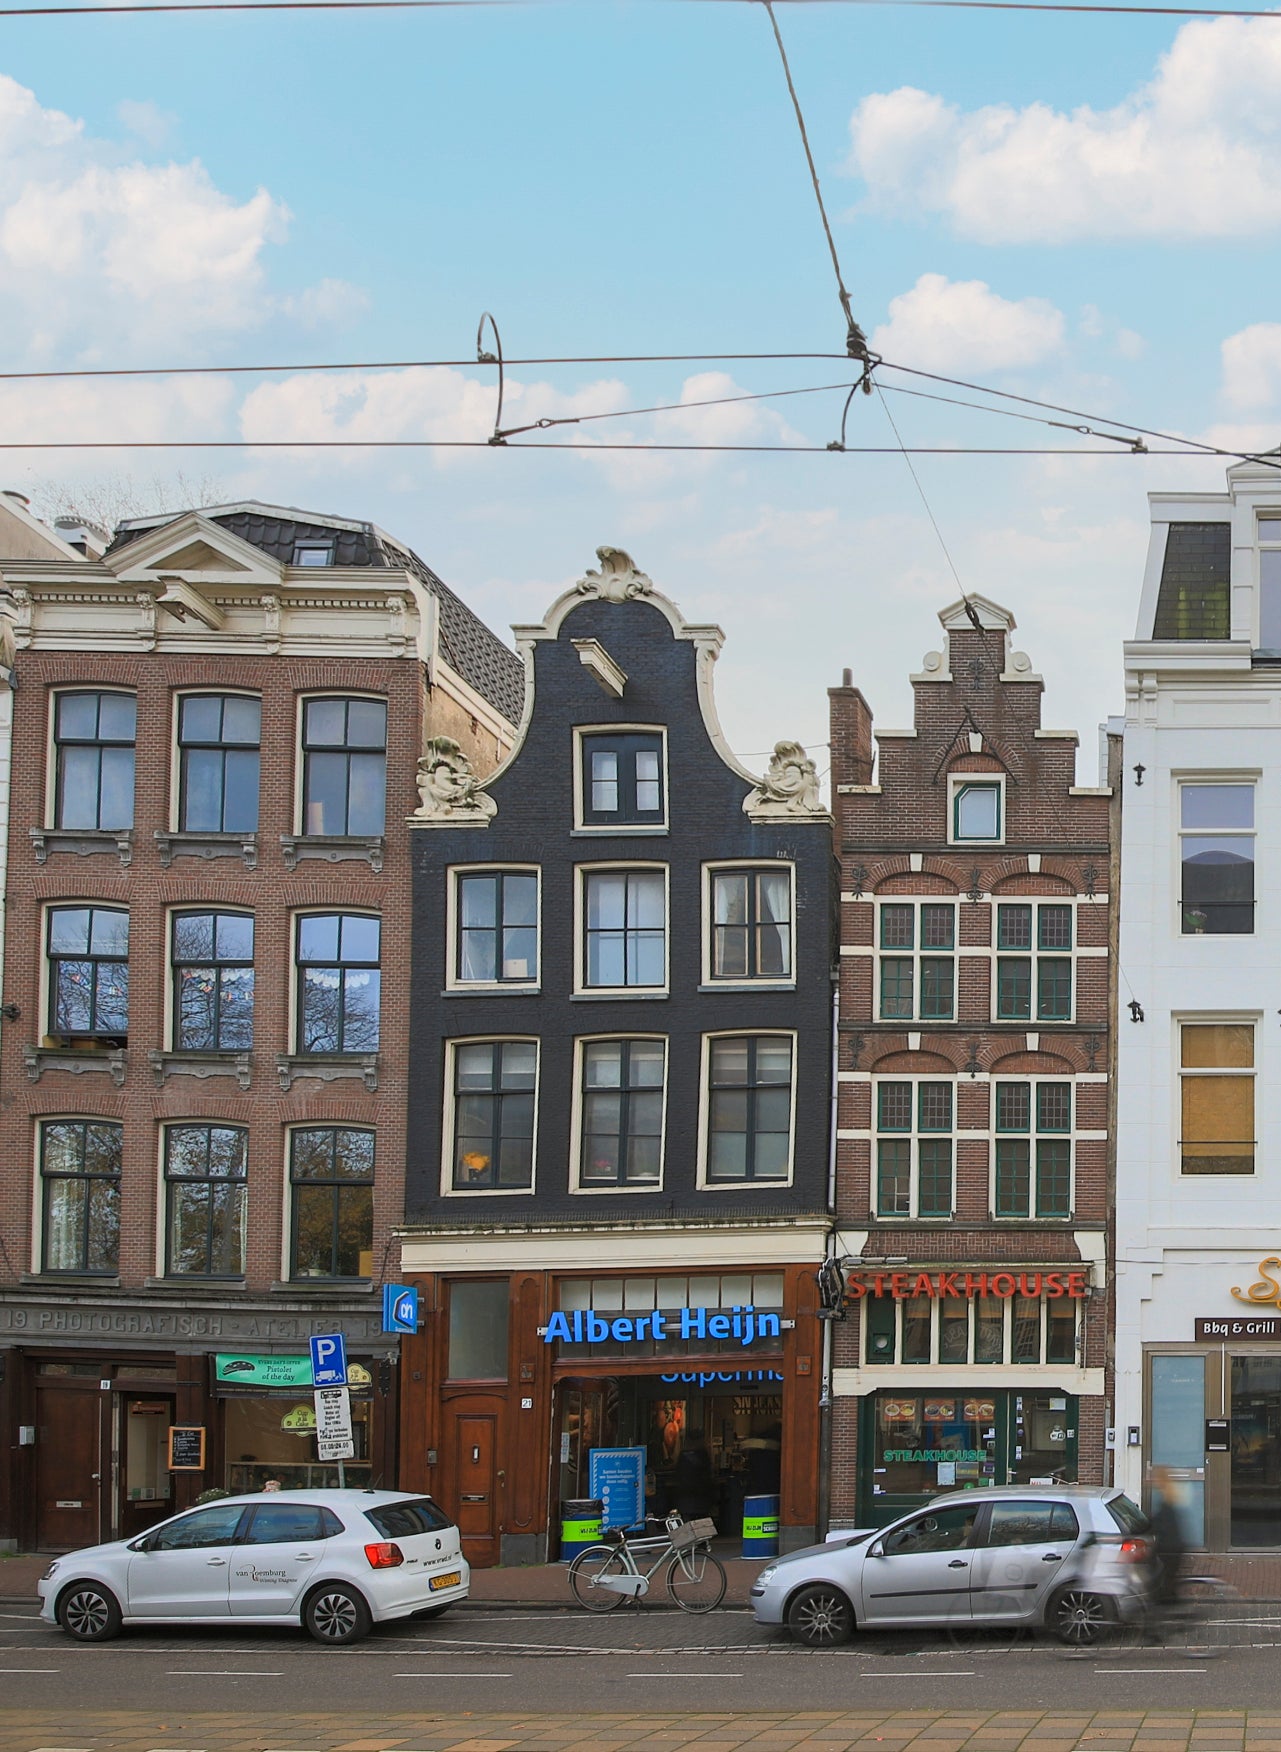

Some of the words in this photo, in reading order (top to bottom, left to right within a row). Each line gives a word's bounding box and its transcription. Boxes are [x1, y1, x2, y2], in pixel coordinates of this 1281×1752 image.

[847, 1272, 1087, 1299] STEAKHOUSE
[7, 1309, 28, 1329] 19
[39, 1311, 224, 1336] PHOTOGRAFISCH
[543, 1309, 667, 1344] Albert
[680, 1304, 781, 1346] Heijn
[1203, 1321, 1229, 1336] Bbq
[1232, 1322, 1243, 1334] &
[1246, 1321, 1275, 1334] Grill
[317, 1339, 336, 1365] P
[267, 1365, 292, 1373] Pistolet
[283, 1373, 296, 1382] day
[883, 1450, 987, 1462] STEAKHOUSE
